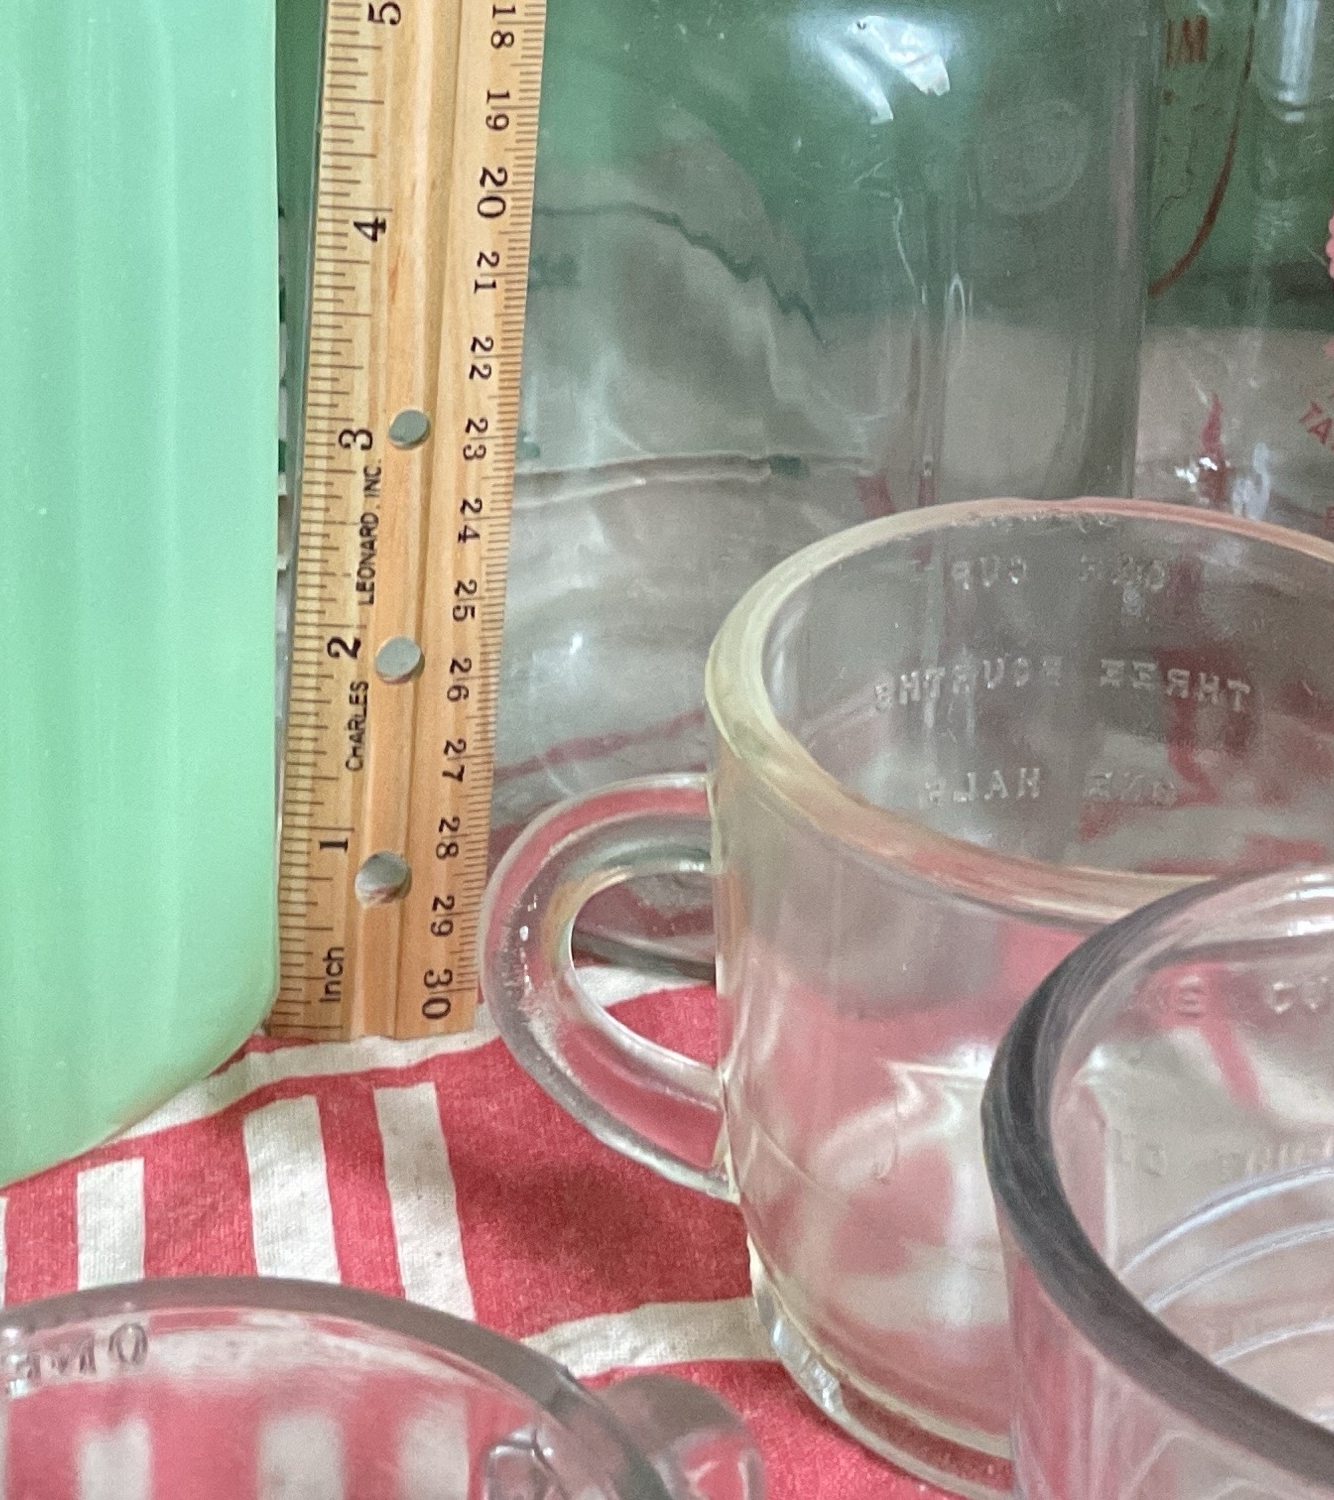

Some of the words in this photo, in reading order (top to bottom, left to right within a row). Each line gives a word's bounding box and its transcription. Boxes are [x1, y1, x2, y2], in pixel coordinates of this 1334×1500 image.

[367, 1, 403, 27] 5
[490, 3, 516, 50] 18
[484, 88, 511, 133] 19
[475, 165, 510, 220] 20
[352, 215, 389, 243] 4
[473, 251, 501, 295] 21
[467, 335, 495, 382] 22
[338, 426, 374, 452] 3
[462, 416, 490, 463] 23
[456, 497, 485, 546] 24
[344, 679, 370, 773] CHARLES
[363, 457, 383, 499] INC.
[451, 578, 479, 624] 25
[326, 636, 362, 661] 2
[445, 656, 474, 703] 26
[441, 736, 468, 785] 27
[318, 837, 349, 854] 1
[435, 815, 461, 861] 28
[430, 895, 456, 938] 29
[421, 968, 454, 1021] 30
